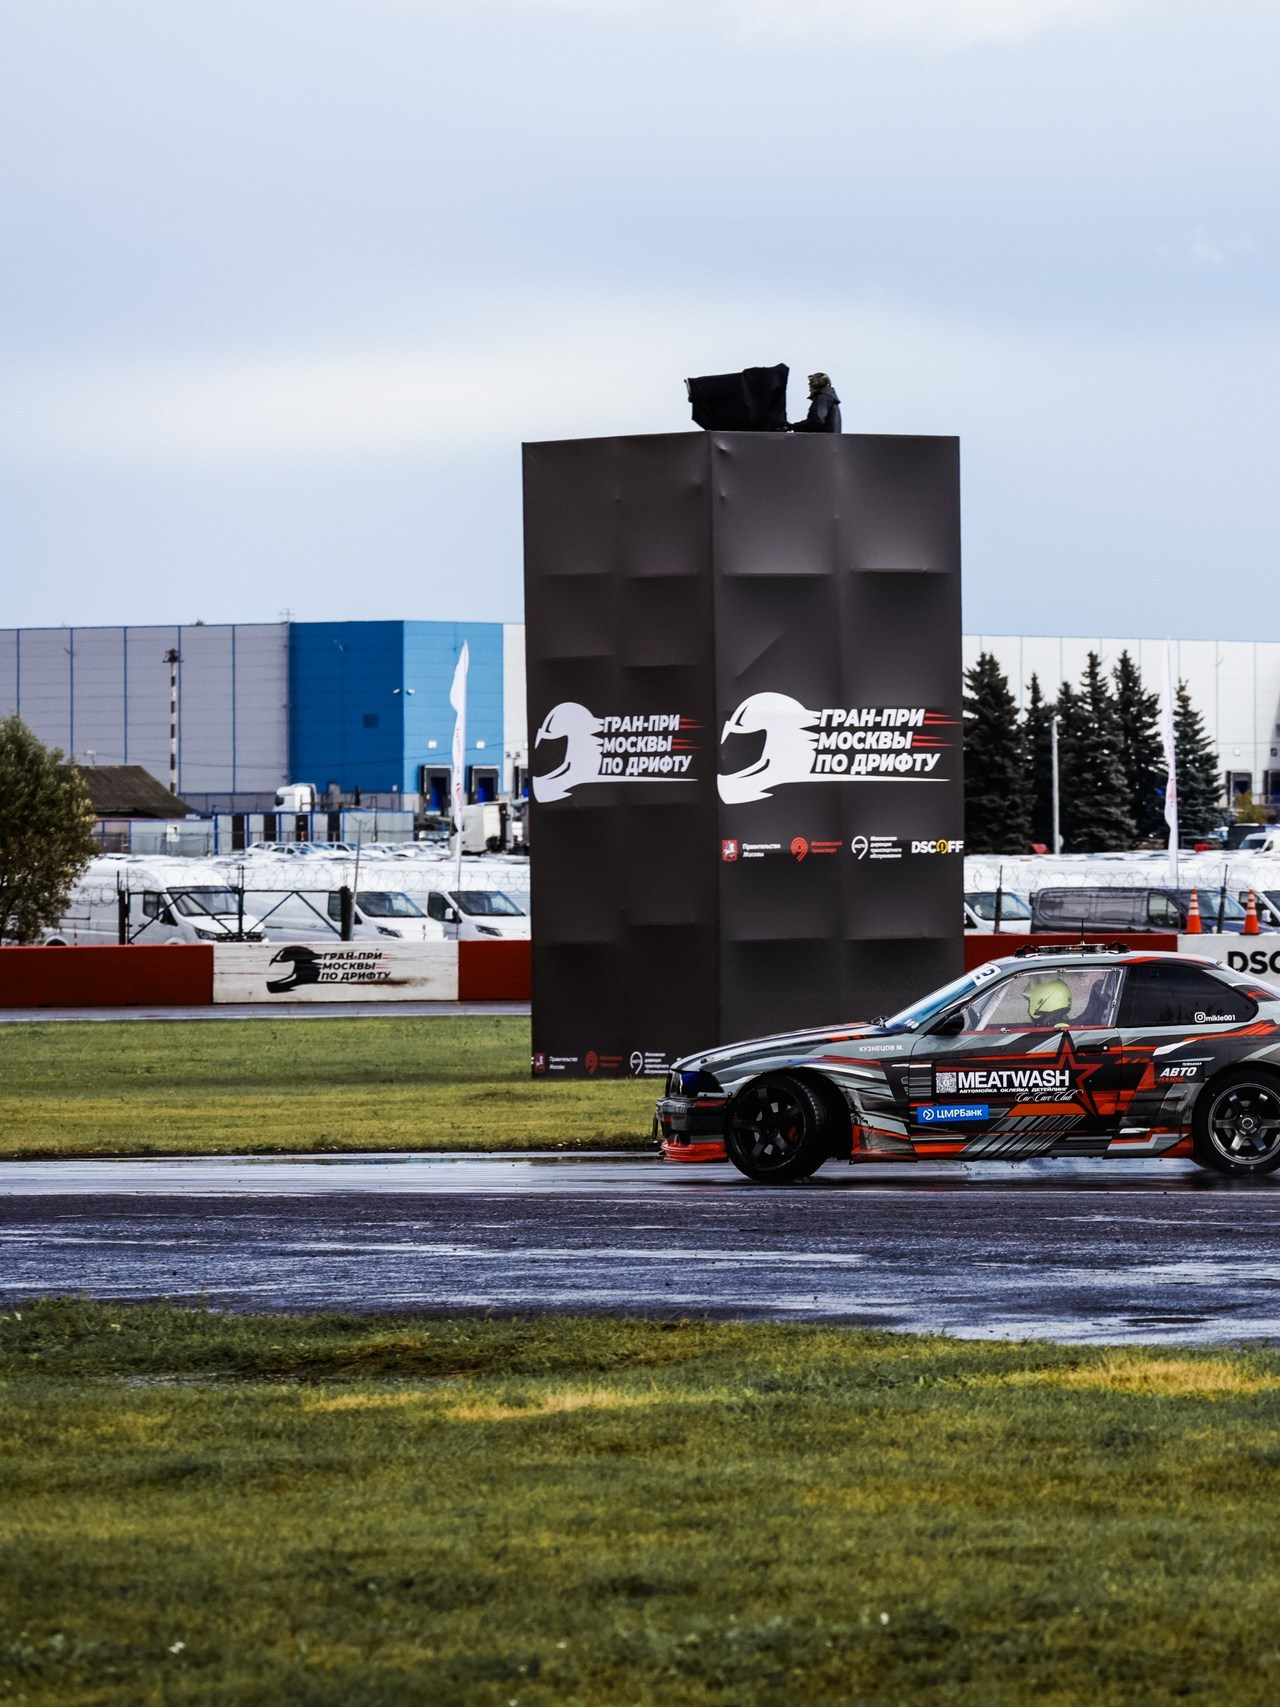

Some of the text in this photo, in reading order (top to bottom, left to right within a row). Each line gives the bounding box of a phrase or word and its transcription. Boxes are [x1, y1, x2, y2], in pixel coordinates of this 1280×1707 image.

[603, 714, 680, 733] ГРАН-ПРИ
[819, 708, 926, 727] ГРАН-ПРИ
[602, 735, 673, 753] МОСКВЫ
[817, 731, 914, 750] МОСКВЫ
[601, 755, 692, 776] ПО ДРИФТУ
[814, 752, 941, 775] ПО ДРИФТУ
[323, 951, 383, 960] ГРАН-ПРИ
[322, 962, 377, 971] МОСКВЫ
[321, 971, 391, 982] ПО ДРИФТУ
[859, 1045, 895, 1053] КУЗНЕЦОВ
[958, 1070, 1070, 1089] MEATWASH
[1160, 1066, 1198, 1078] АВТО
[936, 1108, 983, 1119] ЦМРБанк
